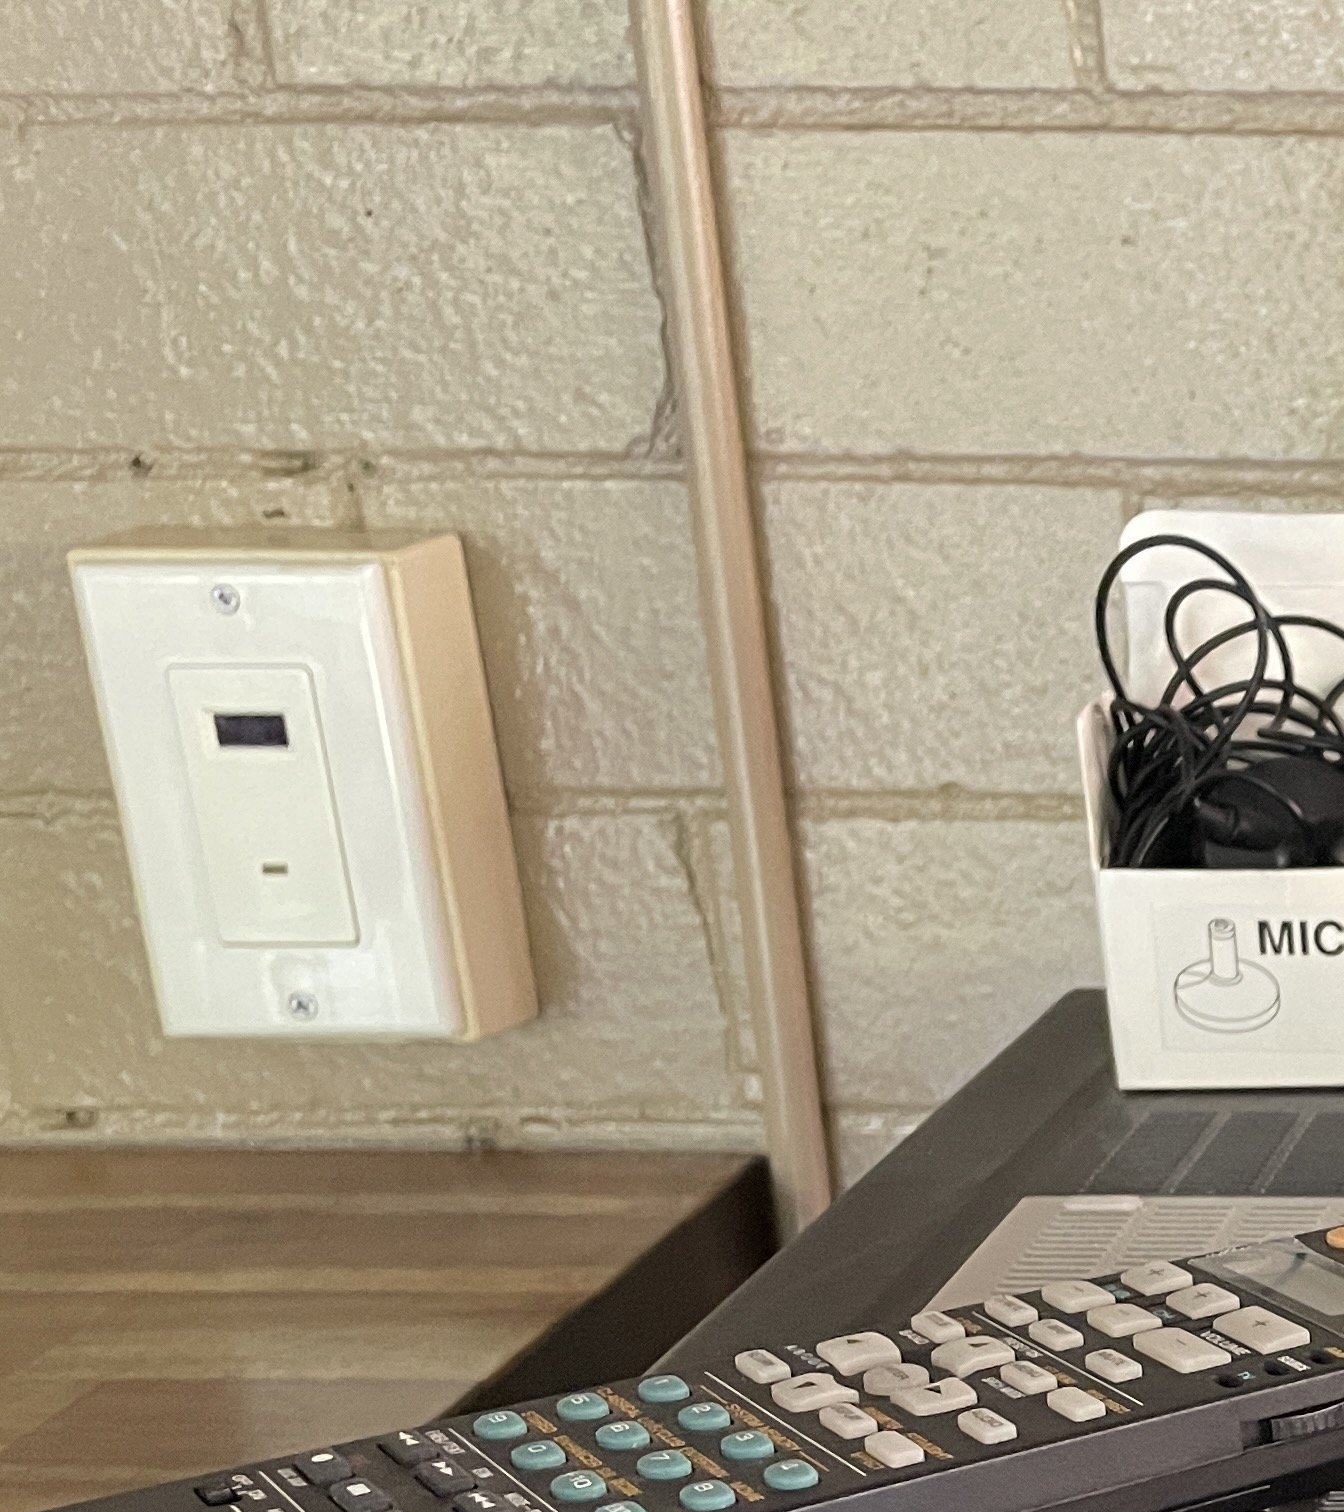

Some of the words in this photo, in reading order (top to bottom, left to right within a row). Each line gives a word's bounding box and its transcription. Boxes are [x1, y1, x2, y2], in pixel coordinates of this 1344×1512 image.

[571, 1395, 590, 1404] 5
[691, 1405, 711, 1413] 2
[488, 1414, 507, 1423] 9
[610, 1422, 630, 1433] 6
[735, 1432, 755, 1442] 3
[527, 1444, 547, 1453] 0
[650, 1452, 670, 1461] 7
[693, 1482, 714, 1493] 8
